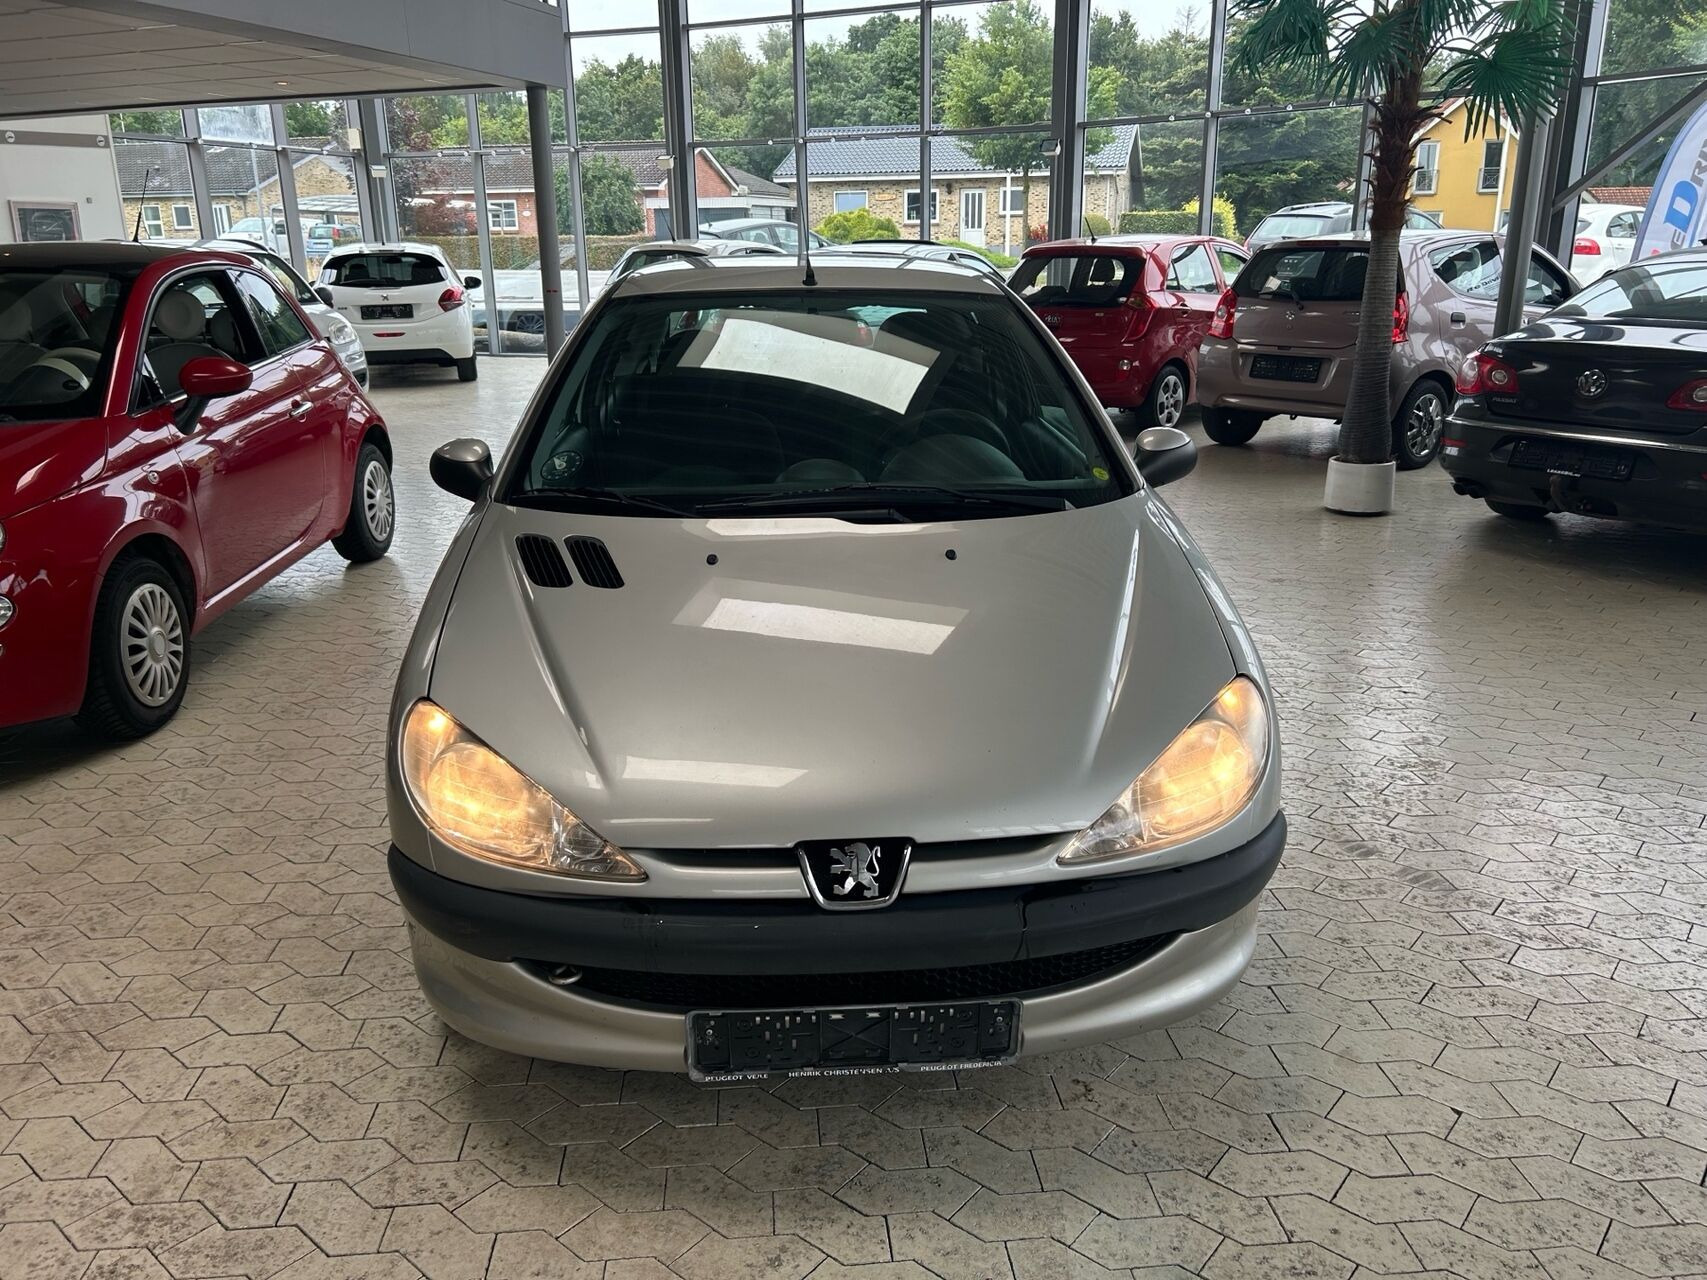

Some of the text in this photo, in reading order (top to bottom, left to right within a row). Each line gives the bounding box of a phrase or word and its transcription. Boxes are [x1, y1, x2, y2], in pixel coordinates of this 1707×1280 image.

[920, 1064, 957, 1072] PEUGEOT
[704, 1074, 743, 1082] PEUGEOT
[788, 1070, 822, 1078] HENRIK
